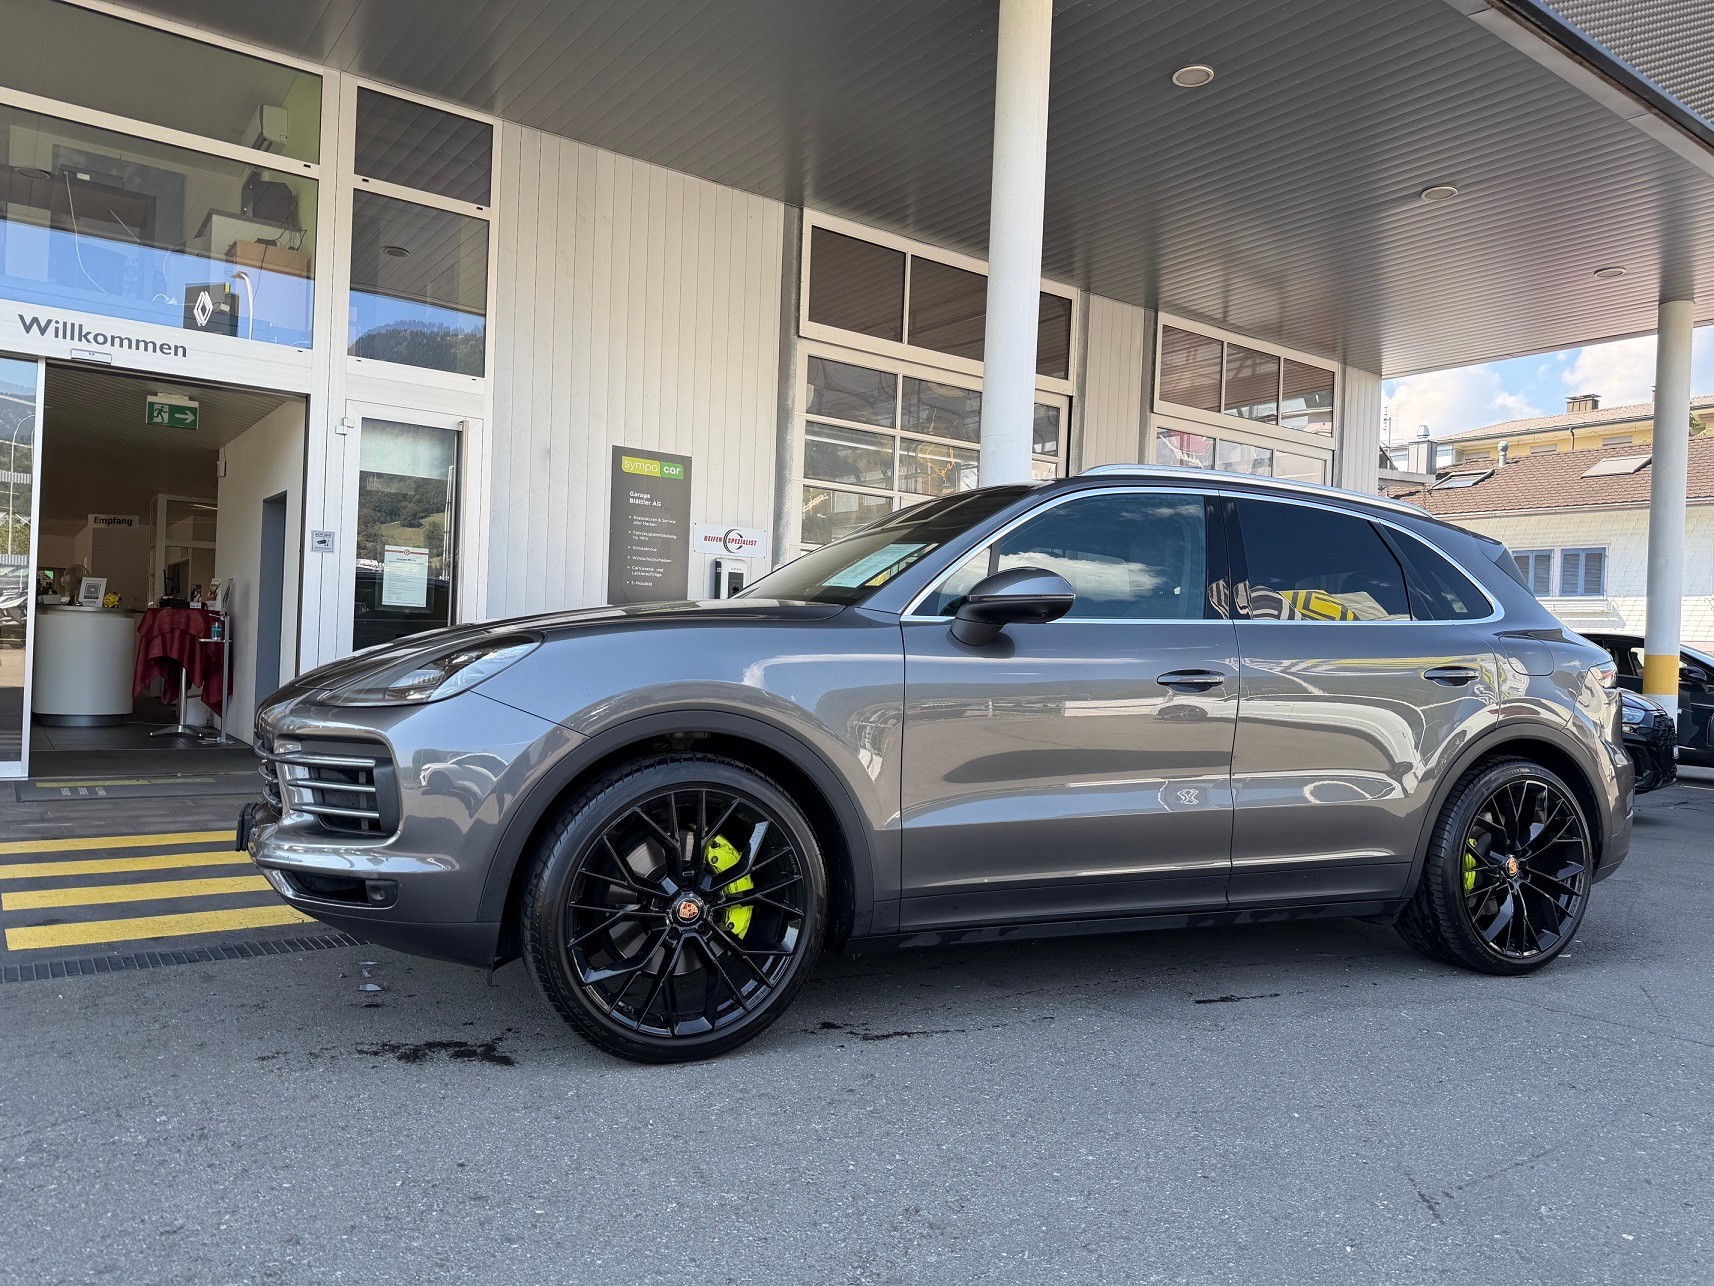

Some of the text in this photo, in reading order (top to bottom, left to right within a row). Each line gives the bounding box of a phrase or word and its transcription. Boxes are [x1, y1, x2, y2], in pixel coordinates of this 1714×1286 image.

[17, 313, 187, 358] Willkommen
[663, 466, 681, 475] car
[629, 490, 651, 499] Garage
[93, 516, 133, 527] Empfang
[703, 535, 758, 547] REIFEN SPEZIALIST
